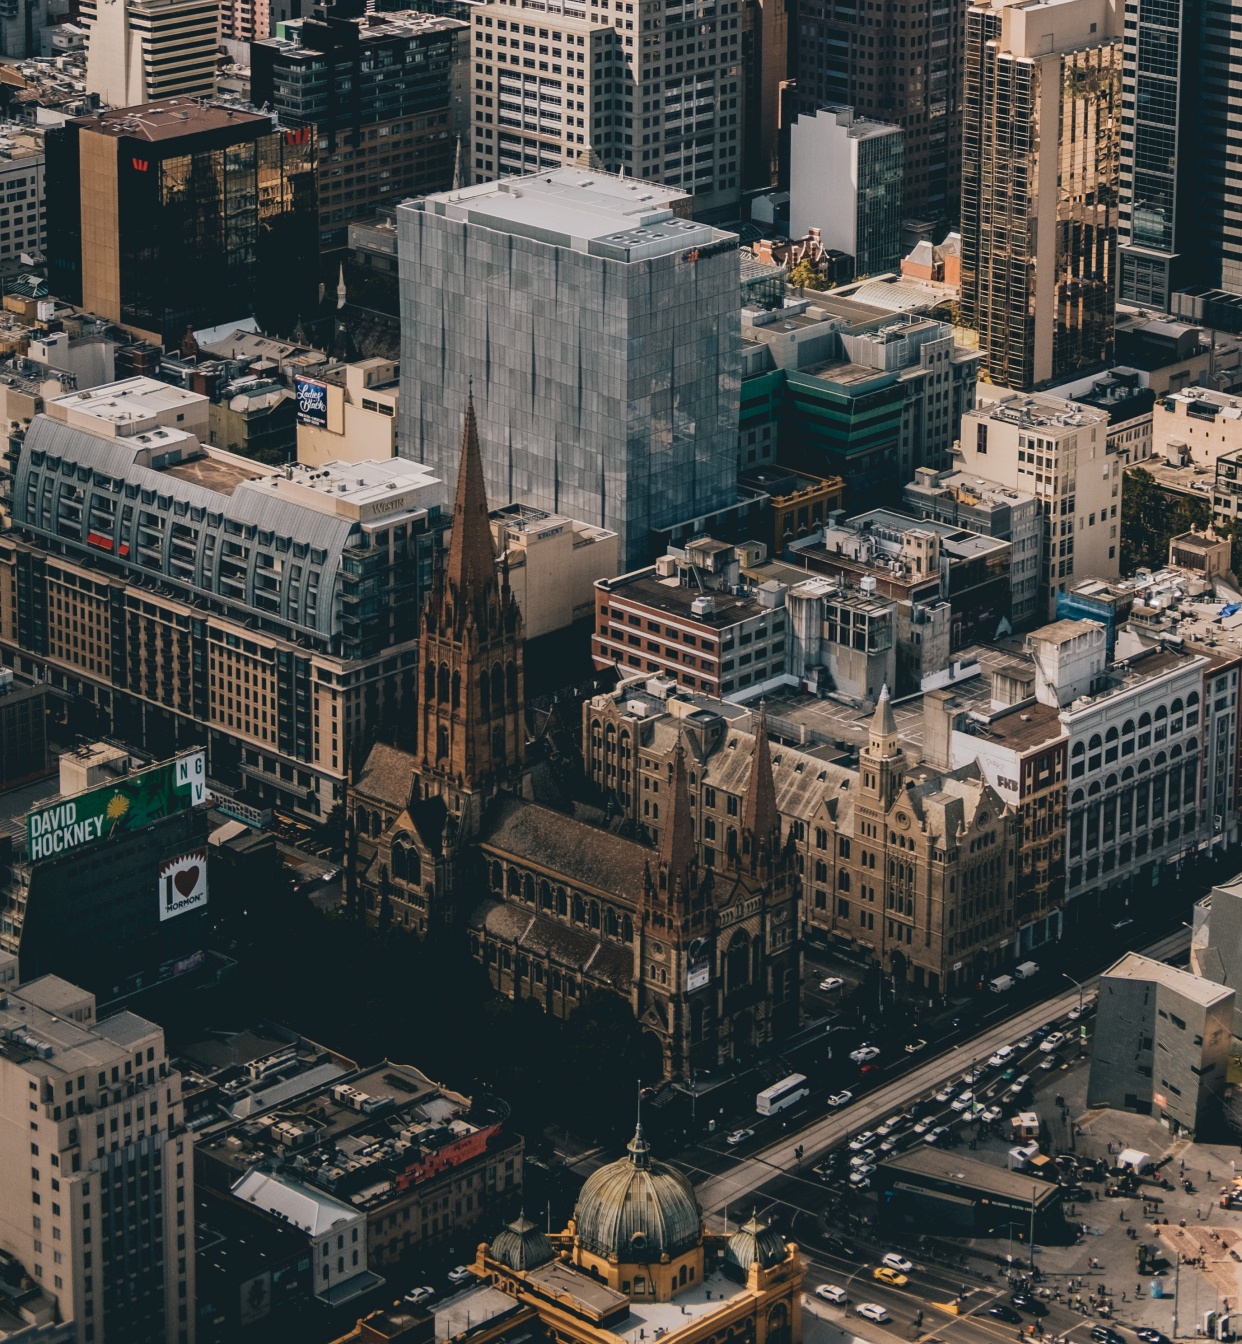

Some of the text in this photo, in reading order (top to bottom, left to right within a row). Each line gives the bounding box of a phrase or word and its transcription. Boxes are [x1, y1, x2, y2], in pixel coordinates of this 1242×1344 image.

[299, 399, 327, 412] Black
[31, 803, 77, 838] DAVID
[32, 814, 104, 861] HOCKNEY
